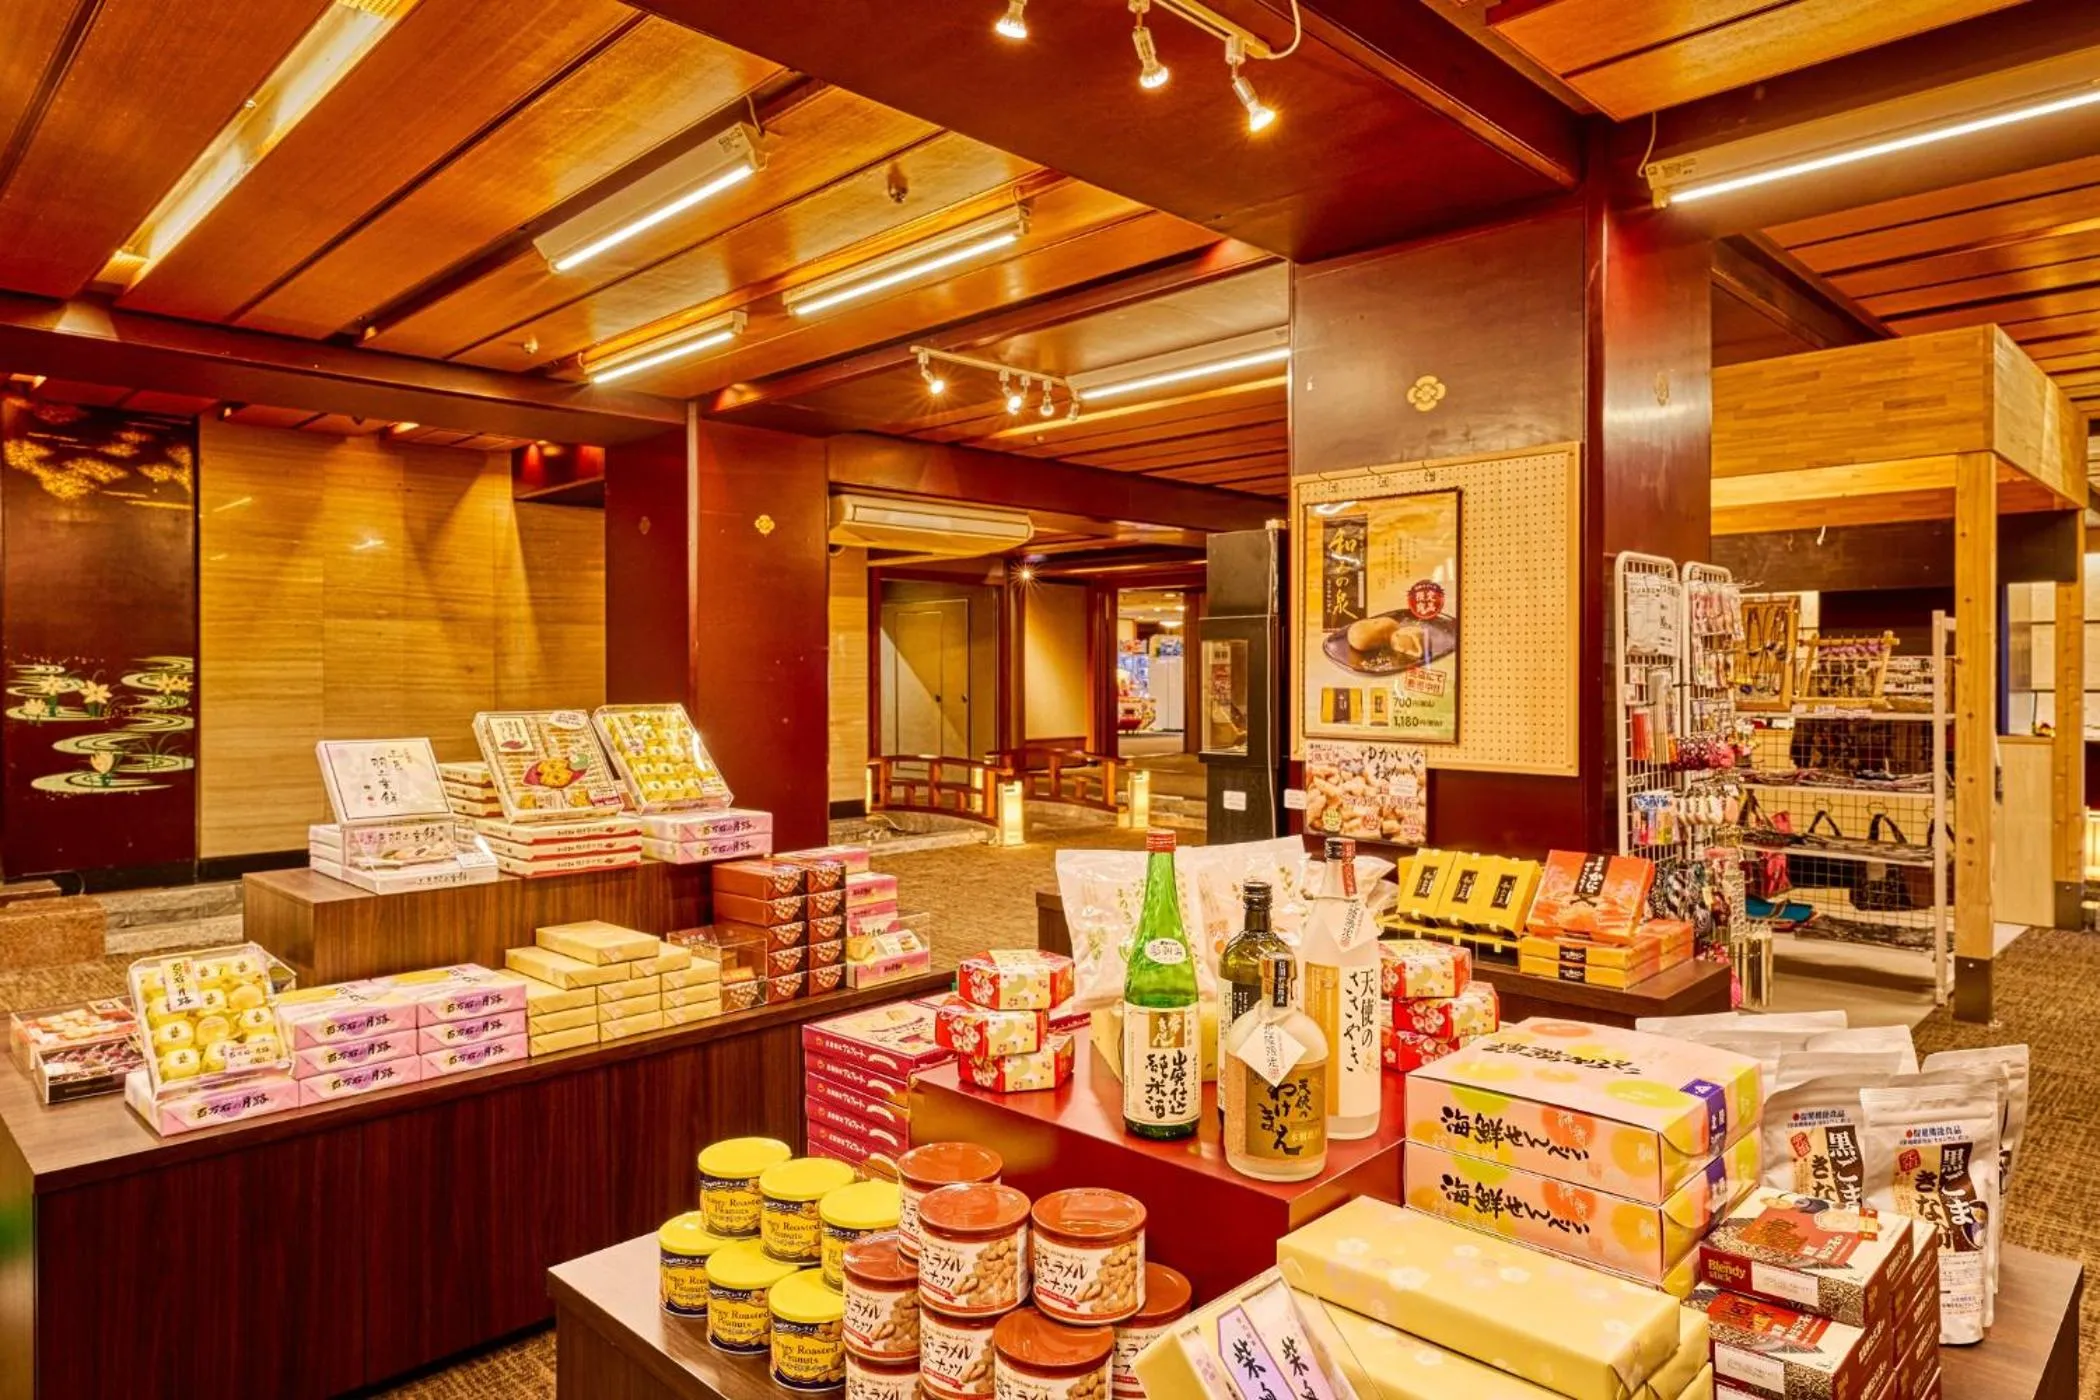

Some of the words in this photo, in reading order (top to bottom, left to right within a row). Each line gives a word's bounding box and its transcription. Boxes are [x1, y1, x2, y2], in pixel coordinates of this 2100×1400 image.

[1342, 971, 1361, 1073] ささやき
[1359, 968, 1376, 1048] 天使の
[1145, 1054, 1169, 1119] 純米酒
[1169, 1049, 1188, 1116] 山廃仕込
[1440, 1105, 1590, 1162] 海鮮せんべい
[1440, 1173, 1591, 1235] 海鮮せんべい
[1940, 1147, 1974, 1225] 黒ごま
[1707, 1258, 1747, 1279] Blendy
[1708, 1269, 1732, 1284] stick
